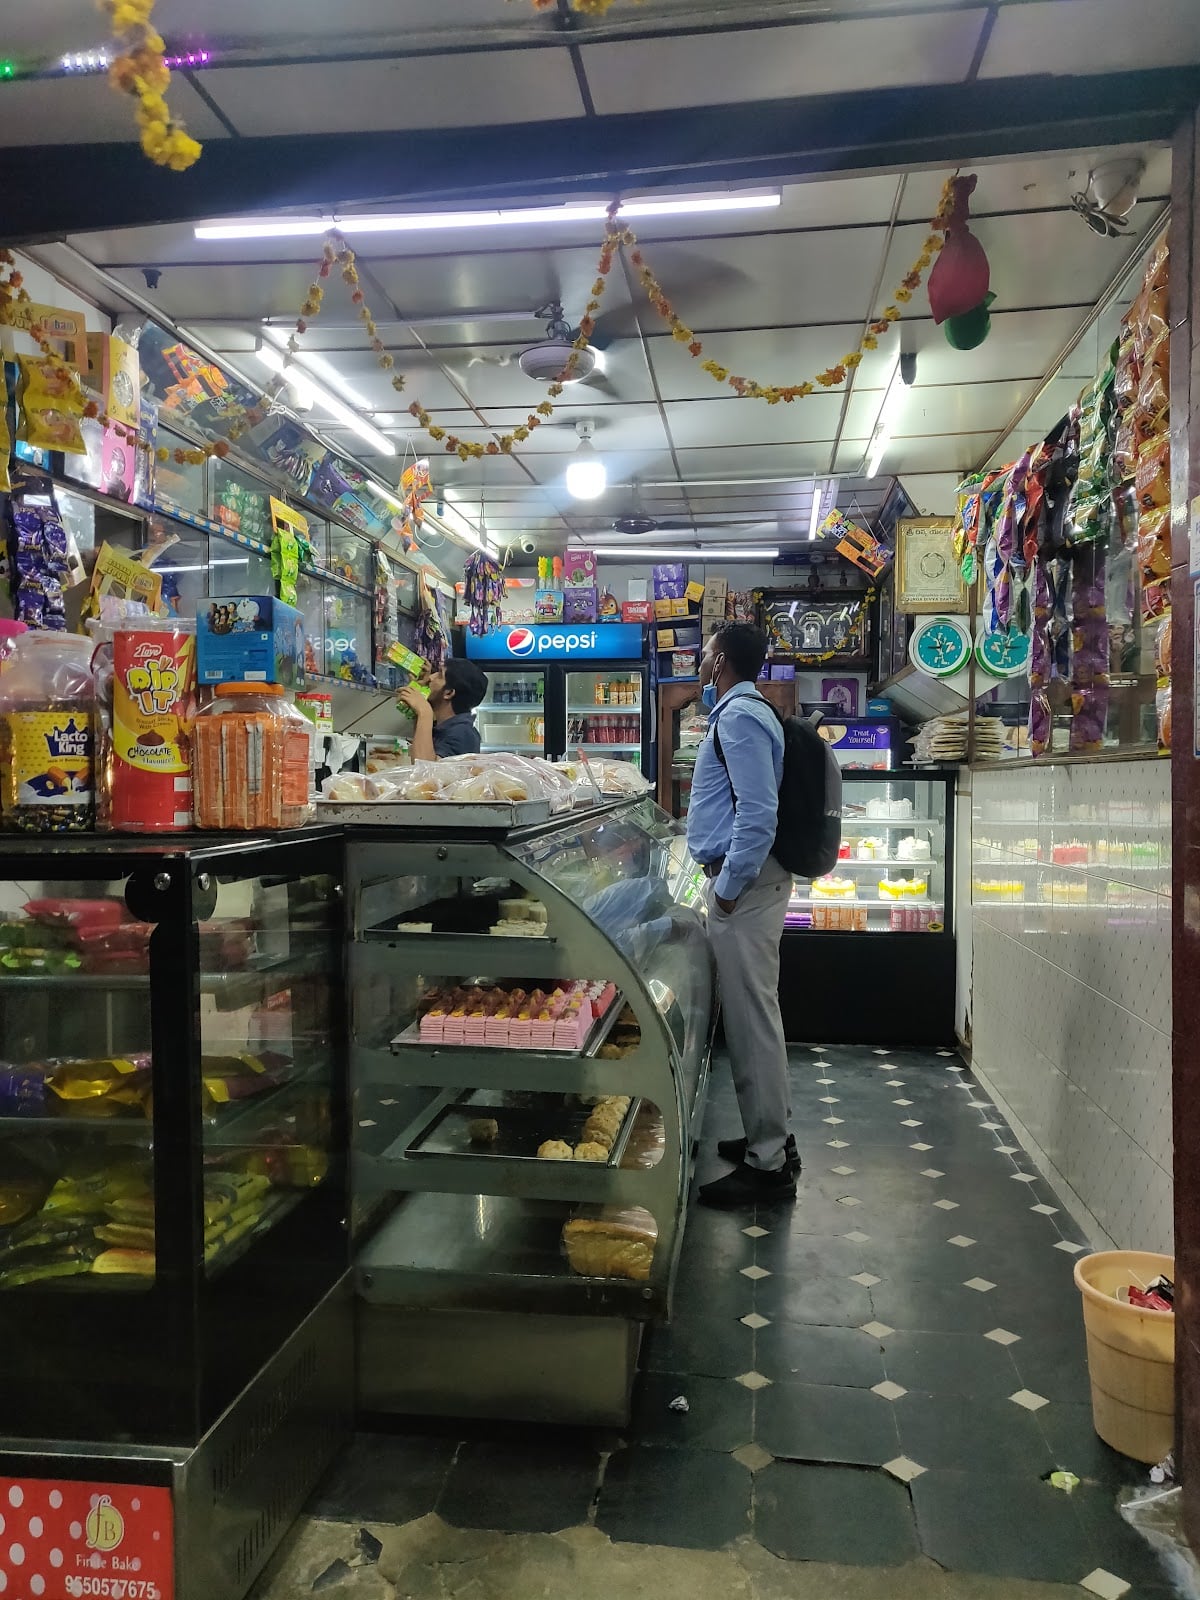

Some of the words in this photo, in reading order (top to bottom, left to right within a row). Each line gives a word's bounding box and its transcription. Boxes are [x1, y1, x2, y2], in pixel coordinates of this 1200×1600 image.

[538, 631, 596, 652] pepsi
[54, 730, 88, 742] Lacto
[848, 734, 876, 746] Yourself
[58, 742, 85, 755] King
